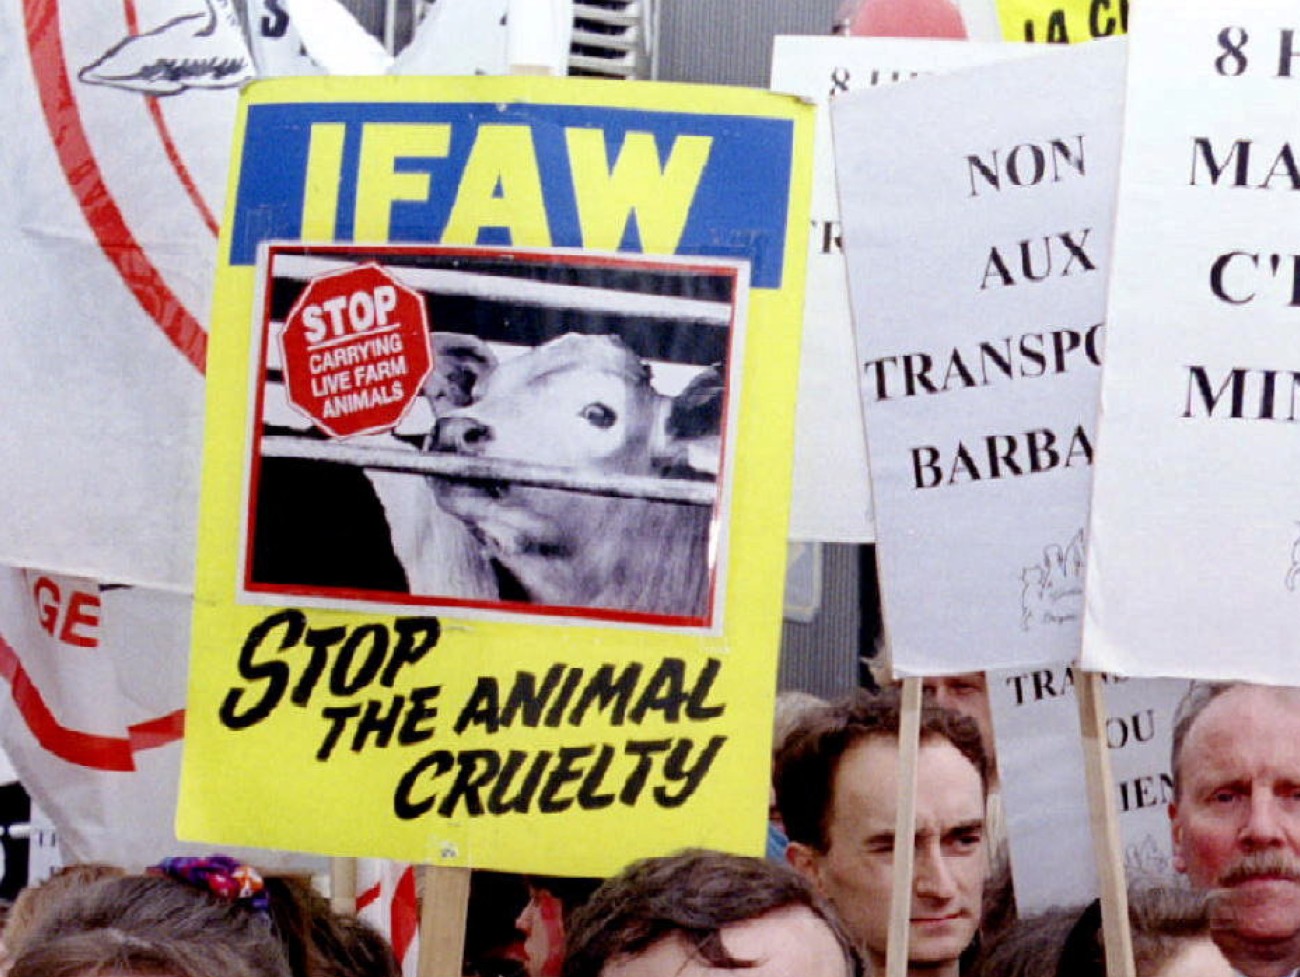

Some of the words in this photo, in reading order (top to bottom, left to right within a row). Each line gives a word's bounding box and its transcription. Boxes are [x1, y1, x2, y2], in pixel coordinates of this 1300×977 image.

[1215, 27, 1249, 76] 8
[299, 123, 711, 256] IFAW
[967, 135, 1085, 196] NON
[980, 228, 1097, 290] AUX
[302, 285, 397, 344] STOP
[309, 333, 403, 375] CARRYING
[310, 370, 352, 397] LIVE
[354, 355, 408, 388] FARM
[323, 381, 405, 418] ANIMALS
[910, 424, 1095, 490] BARBA
[218, 607, 441, 733] STOP
[312, 679, 443, 765] THE
[453, 657, 725, 736] ANIMAL
[393, 731, 727, 821] CRUELTY
